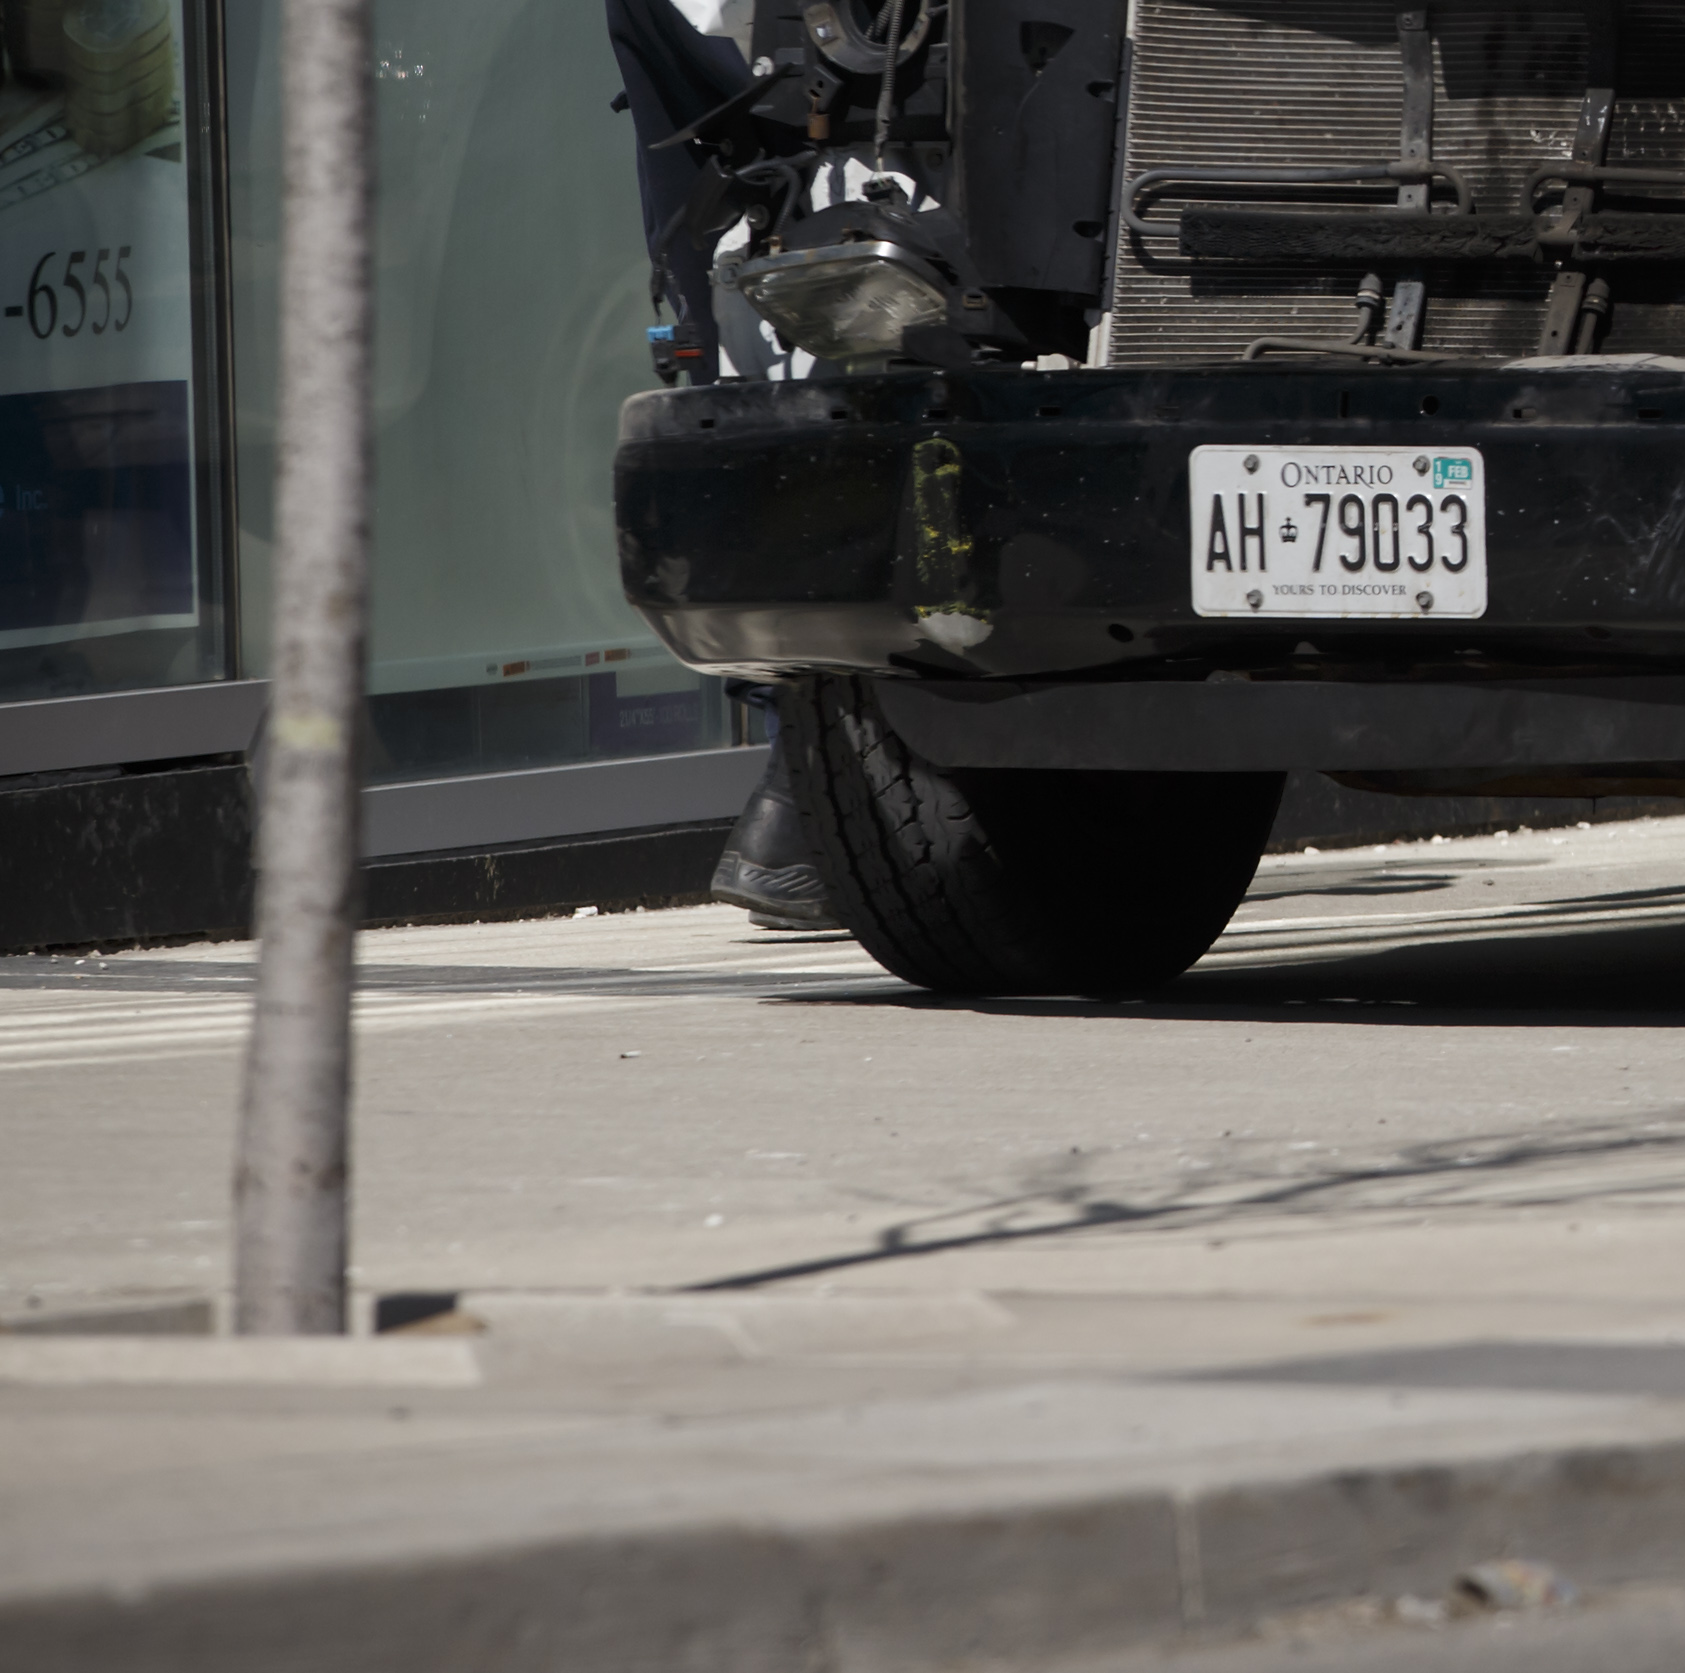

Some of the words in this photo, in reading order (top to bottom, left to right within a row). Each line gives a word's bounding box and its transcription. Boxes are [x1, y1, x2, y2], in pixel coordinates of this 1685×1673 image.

[5, 245, 133, 340] -6555
[1281, 461, 1393, 489] ONTARIO
[1447, 465, 1469, 479] FEB
[1272, 584, 1314, 596] YOURS
[1320, 584, 1337, 596] TO
[1341, 584, 1407, 596] DISCOVER
